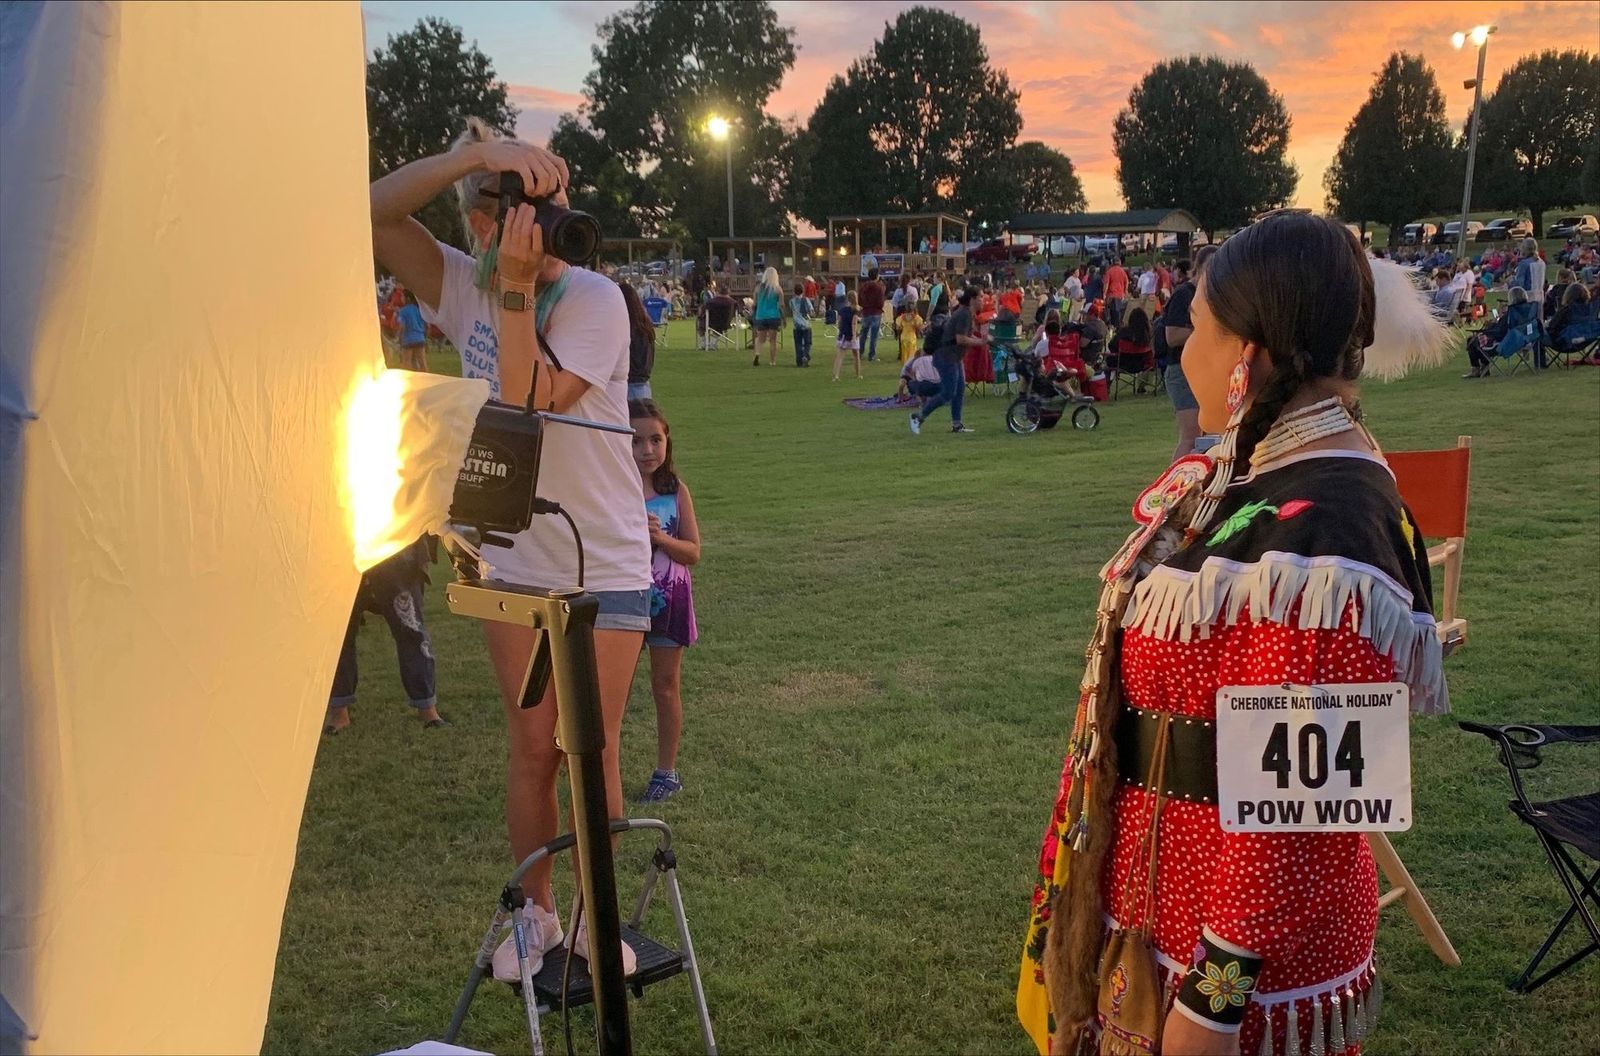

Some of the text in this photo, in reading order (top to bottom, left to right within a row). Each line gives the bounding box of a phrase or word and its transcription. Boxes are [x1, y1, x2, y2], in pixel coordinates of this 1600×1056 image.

[474, 320, 498, 347] SMA
[468, 335, 497, 359] DOW
[465, 349, 494, 374] BLUE
[478, 449, 494, 460] WS
[460, 472, 485, 484] BUFF
[464, 457, 507, 479] STEIN
[1231, 693, 1393, 711] CHEROKEE NATIONAL HOLIDAY
[1261, 720, 1365, 789] 404
[1237, 799, 1393, 825] POW WOW
